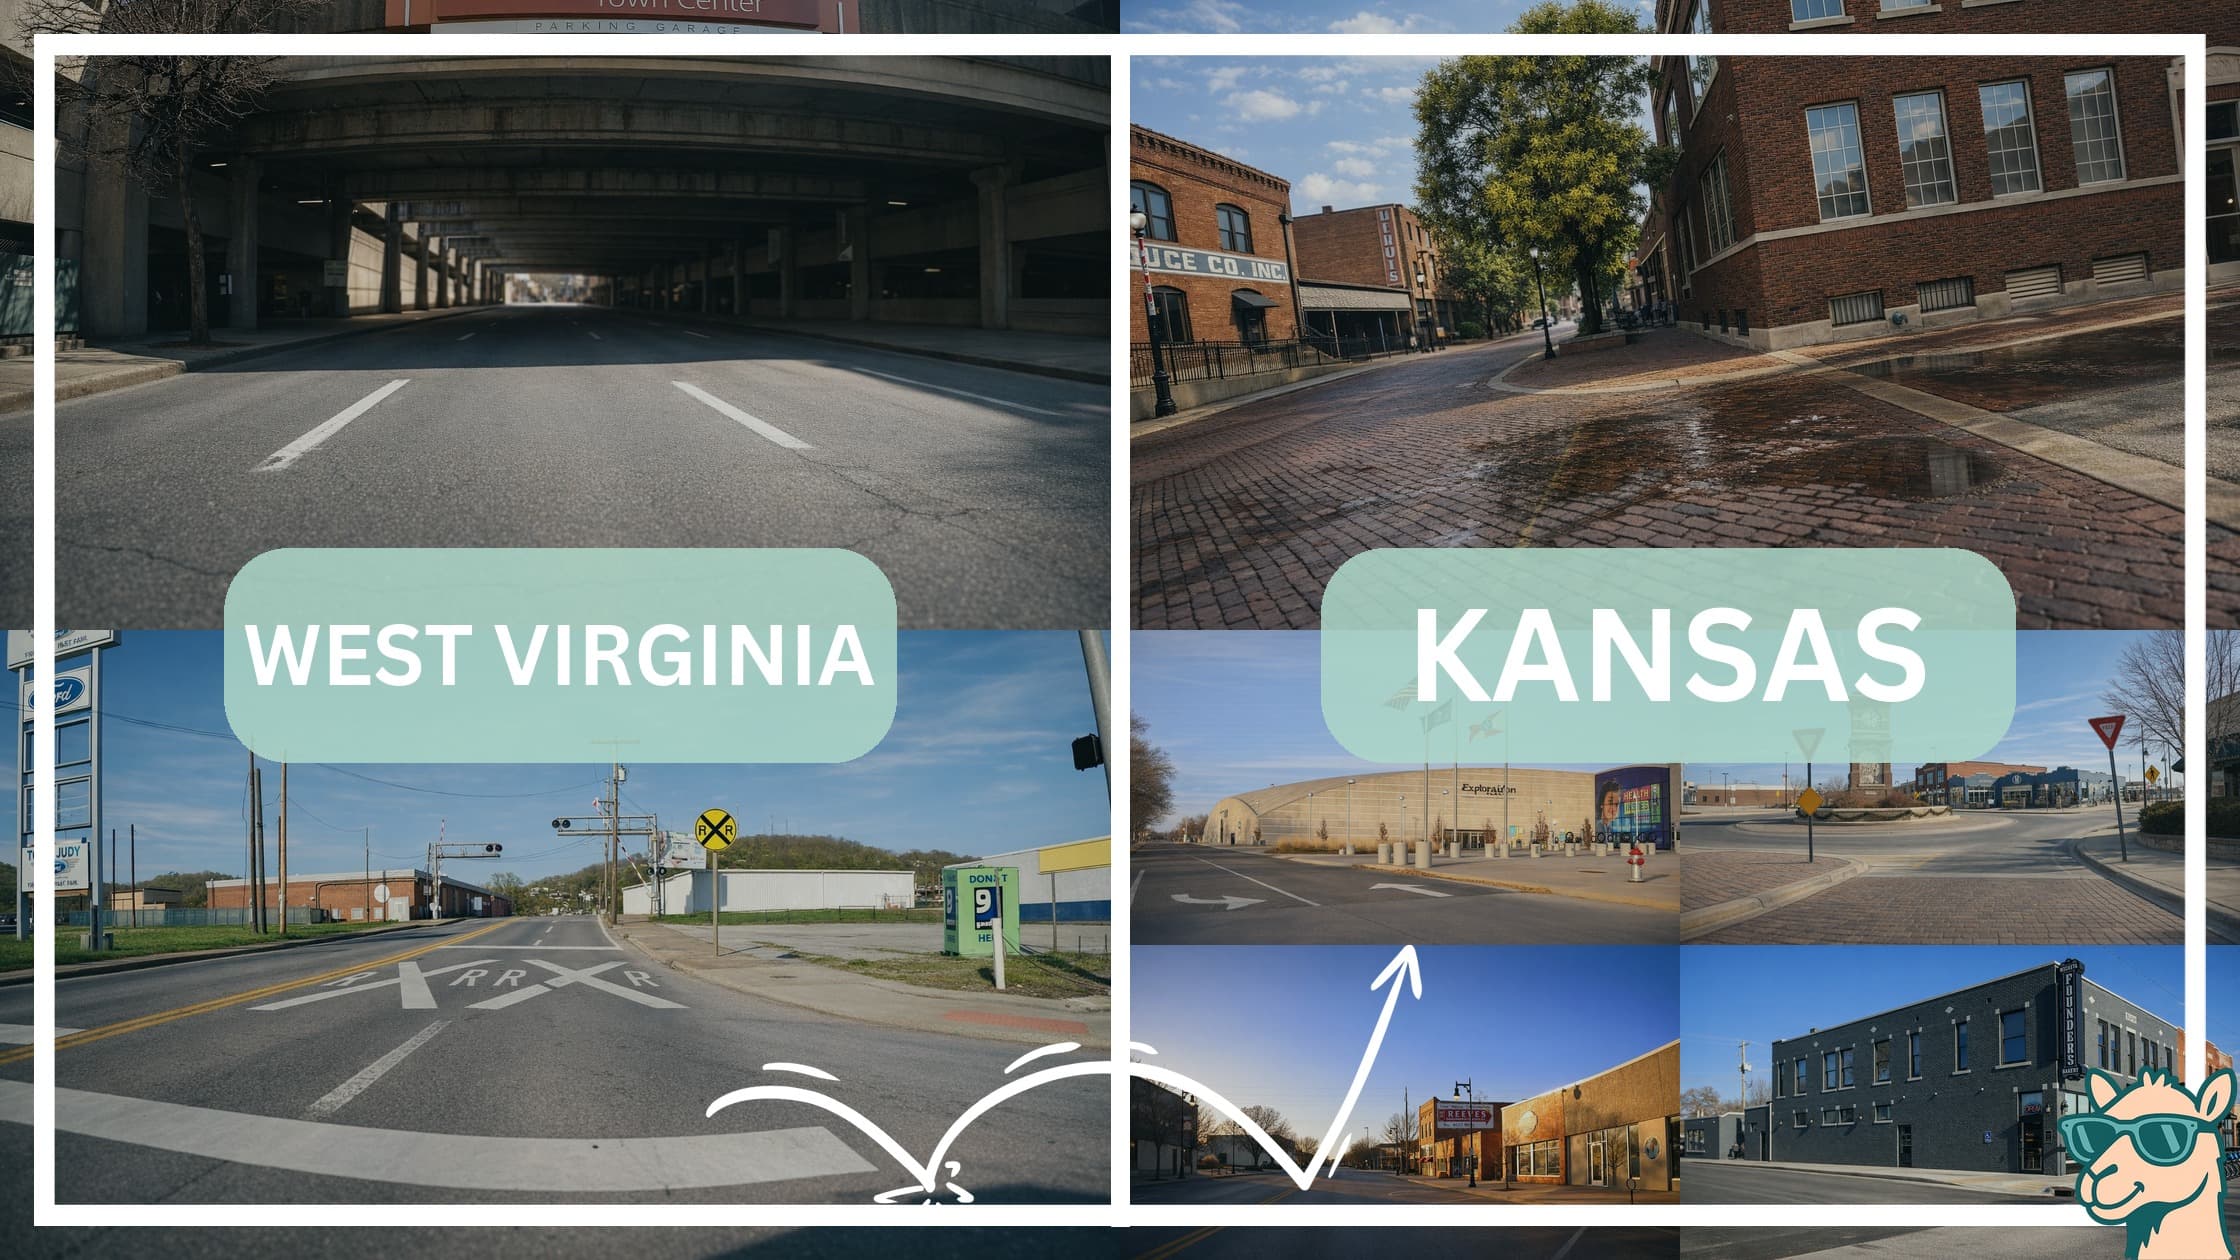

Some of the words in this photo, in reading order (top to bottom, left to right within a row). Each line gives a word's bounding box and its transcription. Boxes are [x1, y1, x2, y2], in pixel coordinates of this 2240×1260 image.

[534, 22, 636, 32] PARKING
[656, 23, 740, 34] GARAGE
[1207, 255, 1246, 277] CO.
[1252, 261, 1286, 281] INC.
[56, 845, 81, 858] JUDY
[969, 874, 1008, 883] DONT
[2065, 973, 2075, 1066] FOUNDERS
